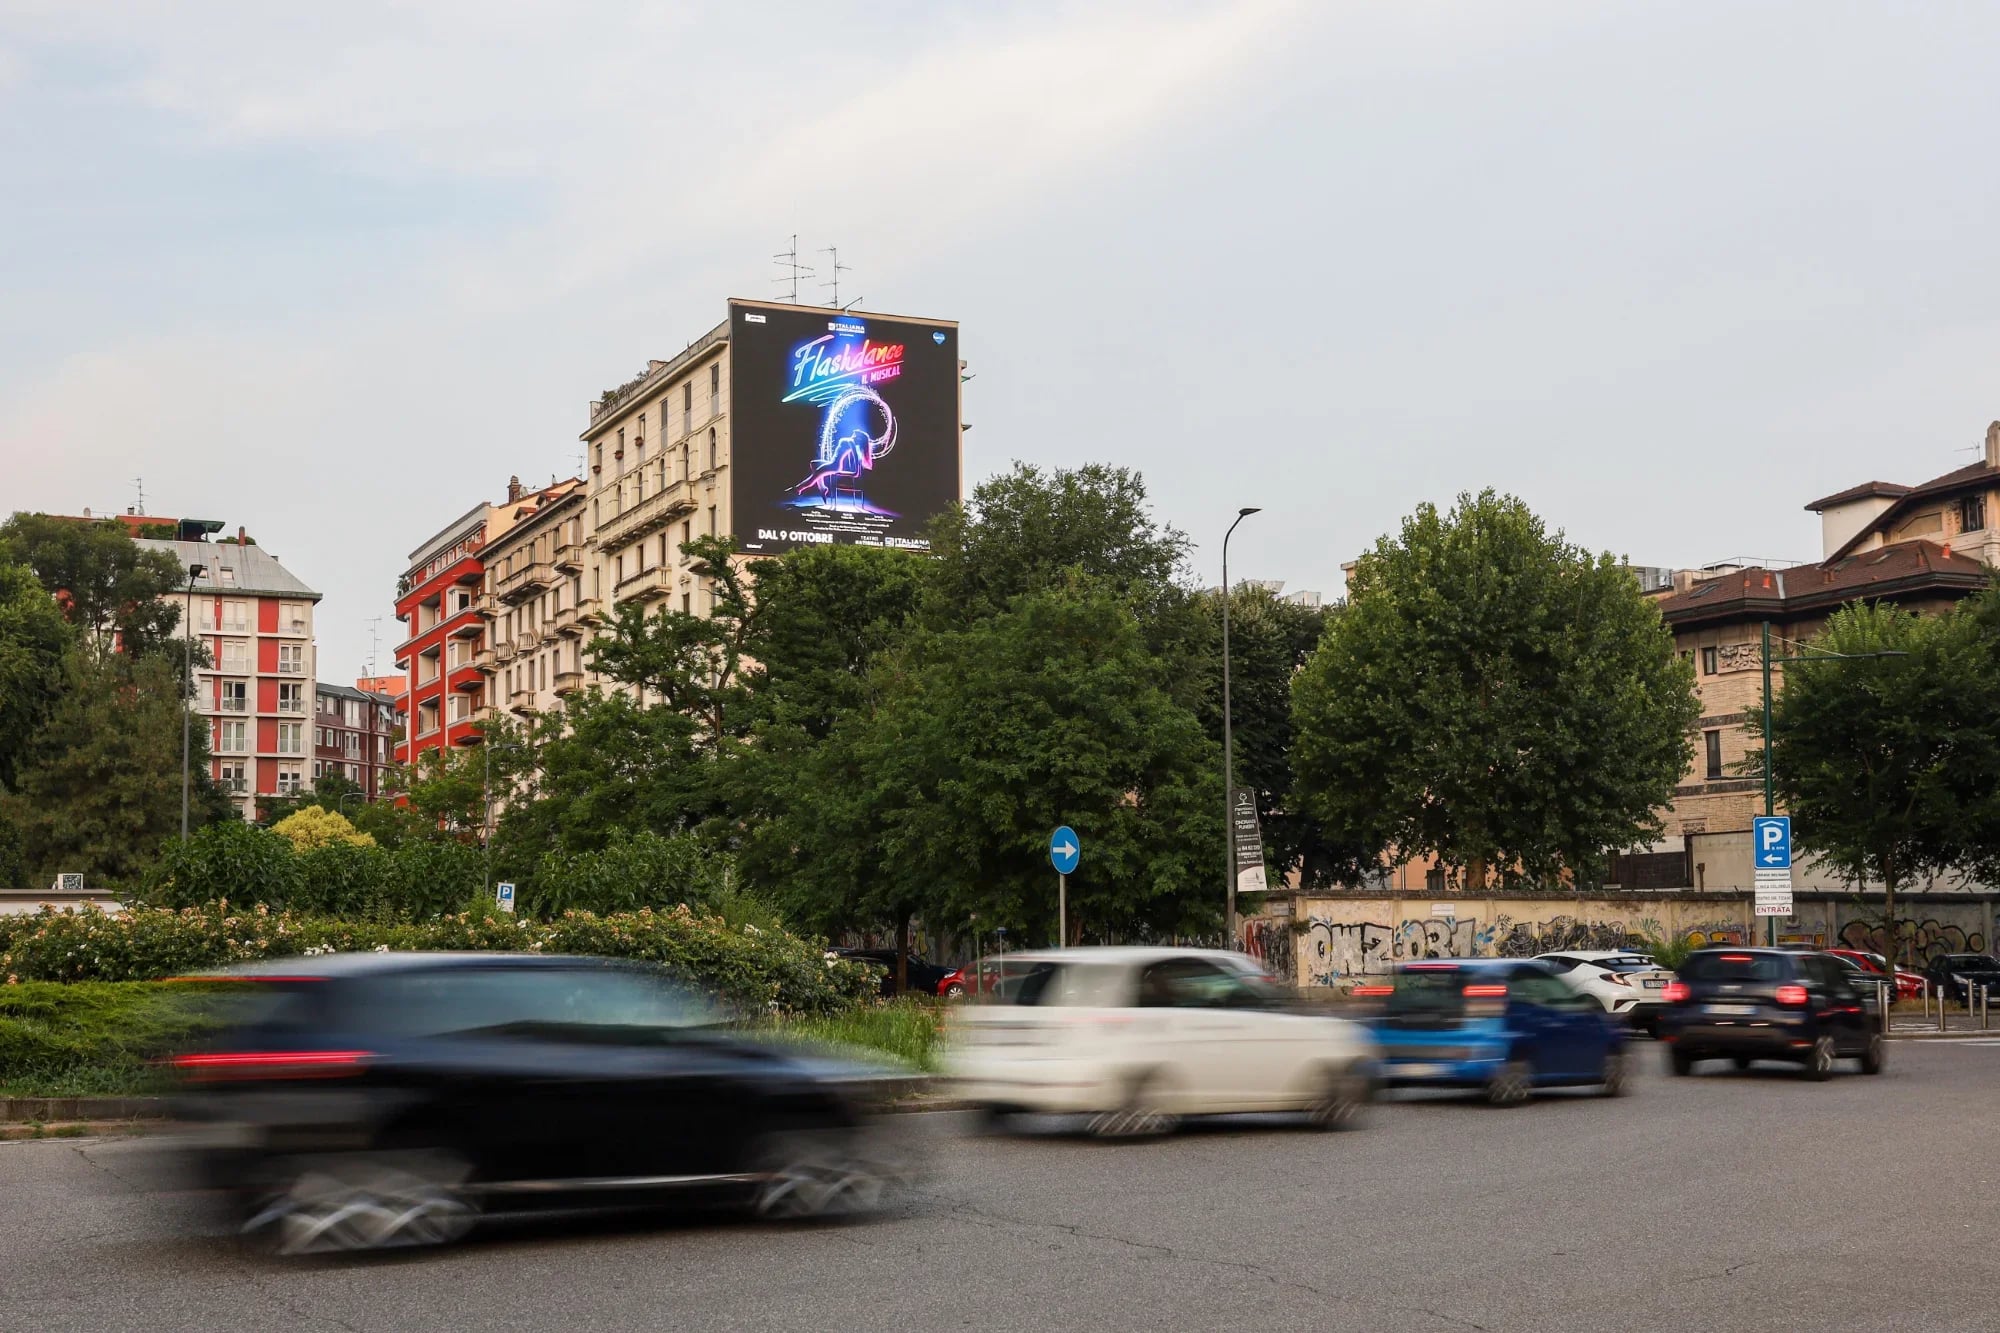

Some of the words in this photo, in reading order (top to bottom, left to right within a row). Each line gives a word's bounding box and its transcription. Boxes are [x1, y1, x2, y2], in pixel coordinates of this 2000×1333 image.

[836, 323, 865, 331] ITALIANA
[794, 334, 904, 387] Flashdance
[861, 375, 868, 385] IL
[870, 365, 901, 383] MUSICAL
[758, 529, 778, 540] DAL
[780, 530, 788, 541] 9
[789, 531, 834, 544] OTTOBRE
[895, 537, 930, 545] ITALIANA
[1763, 827, 1783, 851] P
[502, 887, 510, 898] P
